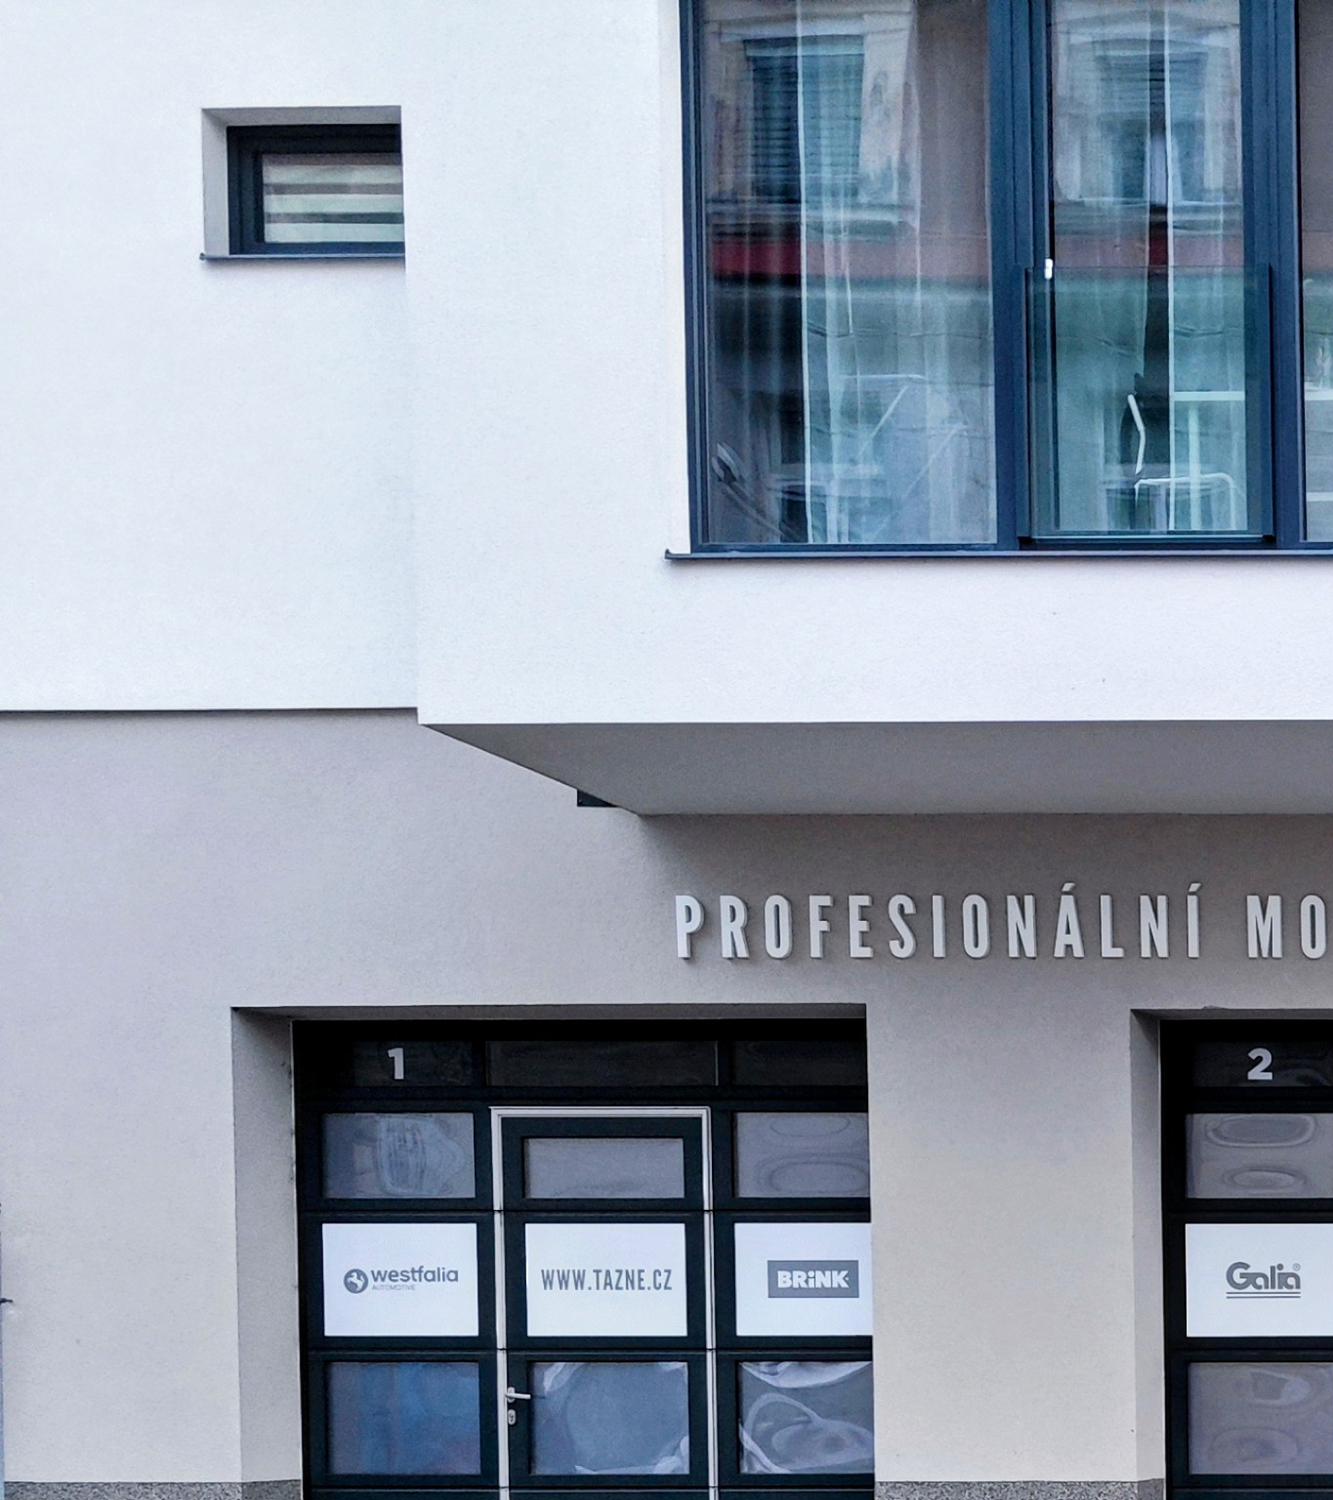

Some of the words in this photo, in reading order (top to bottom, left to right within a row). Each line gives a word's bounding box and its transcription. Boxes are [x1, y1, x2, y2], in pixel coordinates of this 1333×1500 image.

[675, 883, 1201, 961] PROFESIONÁLNÍ
[387, 1047, 404, 1080] 1
[1247, 1047, 1273, 1080] 2
[371, 1265, 459, 1283] westfalia
[541, 1268, 673, 1291] WWW.TAZNE.CZ
[1226, 1261, 1301, 1290] Galia
